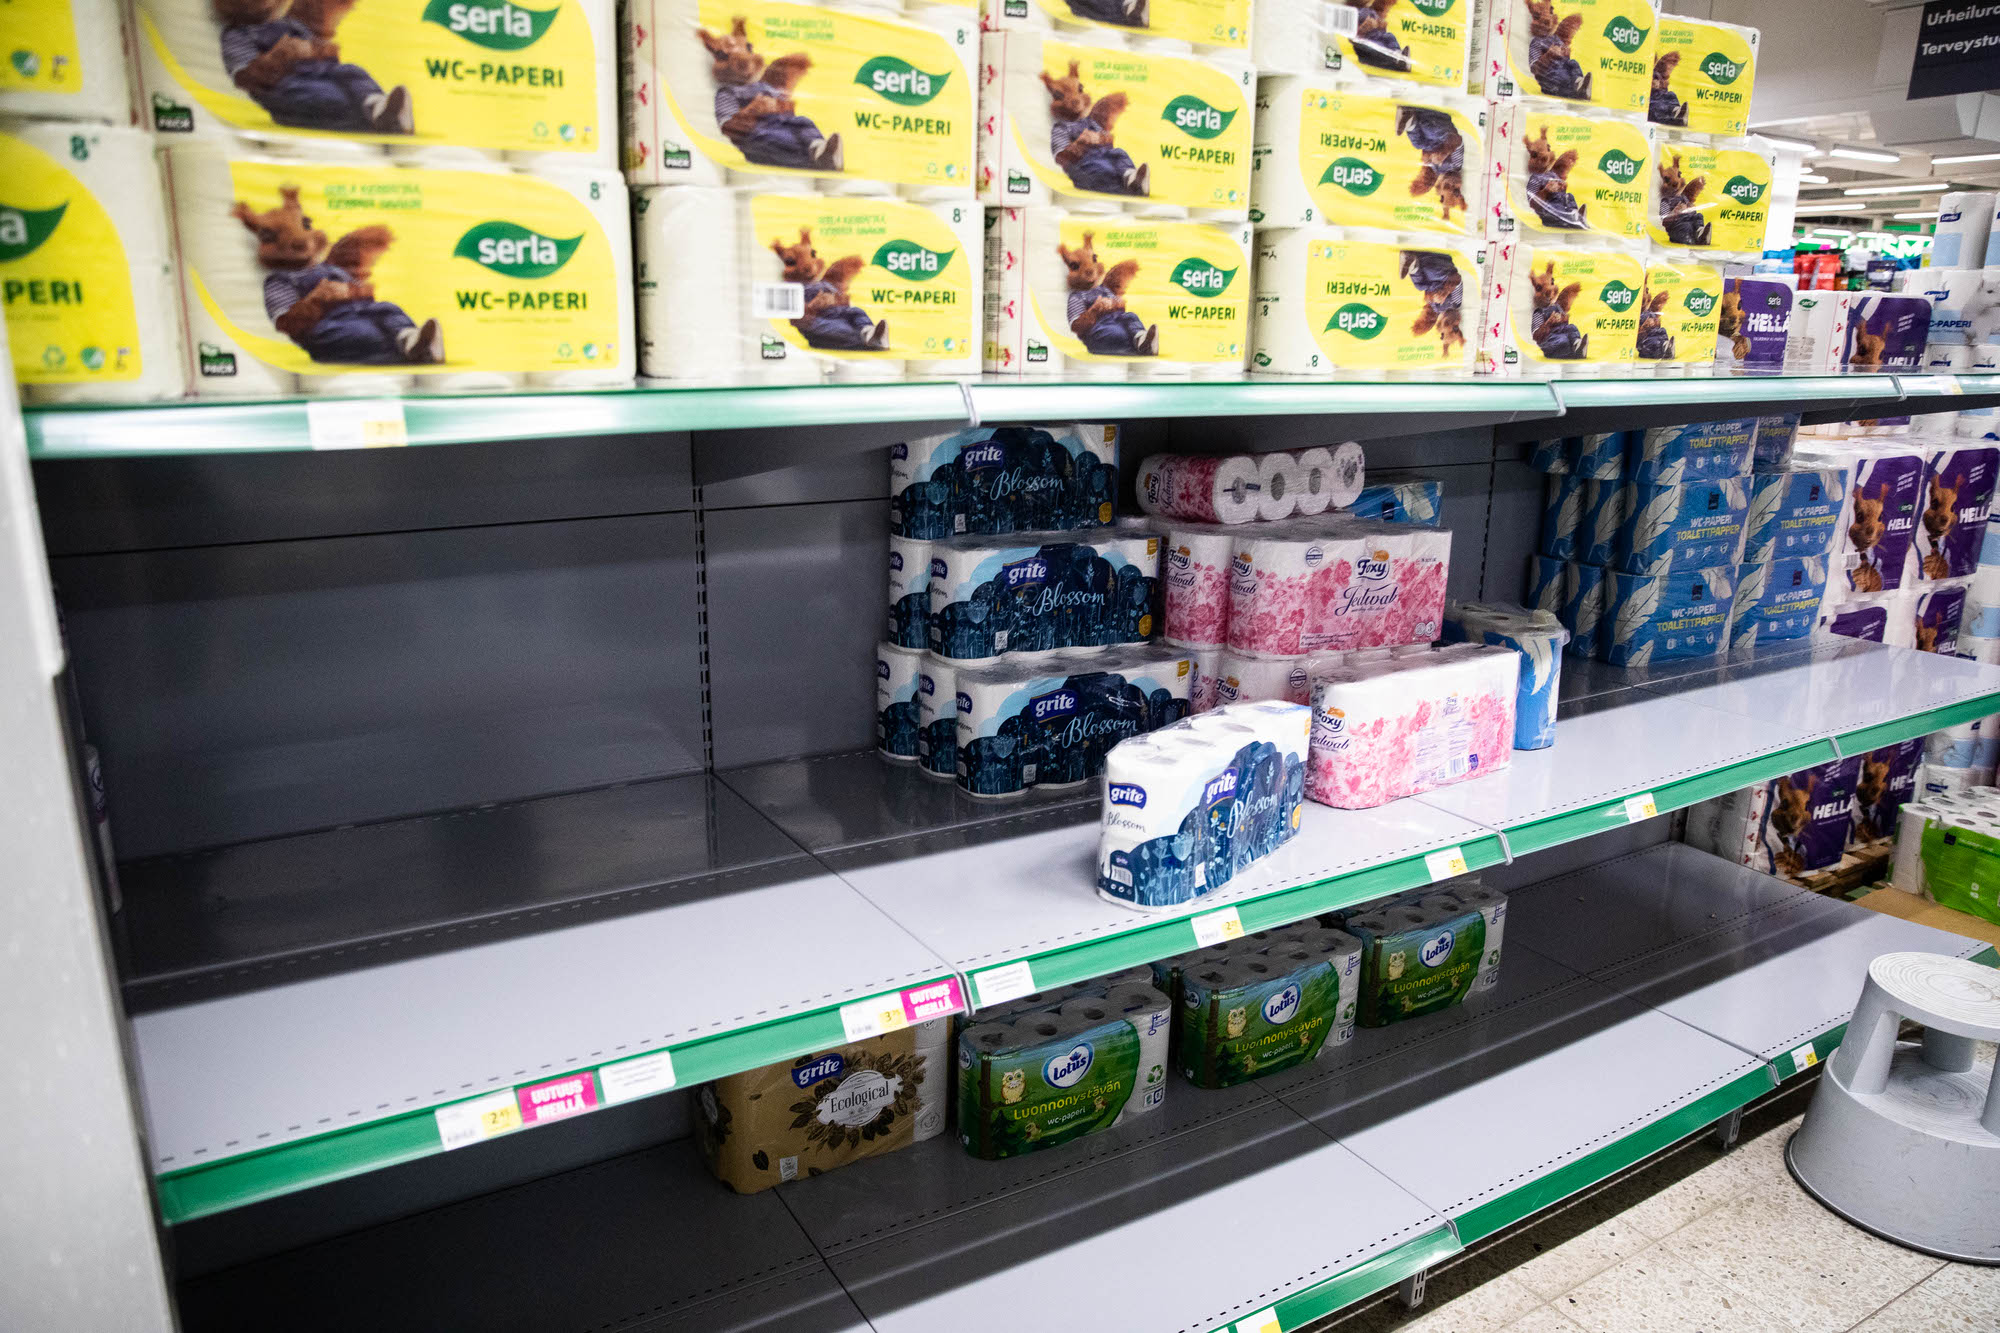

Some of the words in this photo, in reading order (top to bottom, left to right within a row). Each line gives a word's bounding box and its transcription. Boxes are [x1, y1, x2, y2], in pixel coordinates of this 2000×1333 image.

[449, 2, 532, 37] serla
[1401, 19, 1456, 39] WC-PAPERI
[1612, 27, 1640, 46] serla
[1921, 35, 2000, 56] Terveystu
[425, 58, 564, 87] WC-PAPERI
[1600, 57, 1646, 75] WC-PAPERI
[1708, 60, 1736, 78] serla
[872, 69, 931, 96] serla
[1696, 88, 1742, 104] WC-PAPERI
[855, 112, 951, 135] WC-PAPERI
[1175, 106, 1222, 130] serla
[1320, 133, 1386, 152] WC-PAPERI
[1161, 144, 1235, 165] WC-PAPERI
[1333, 165, 1374, 186] serla
[1606, 156, 1635, 176] serla
[1595, 189, 1642, 203] WC-PAPERI
[1731, 179, 1759, 199] serla
[1720, 209, 1763, 223] WC-PAPERI
[478, 234, 558, 264] serla
[886, 248, 938, 272] serla
[1182, 268, 1223, 289] serla
[1326, 281, 1391, 296] WC-PAPERI
[456, 291, 588, 310] WC-PAPERI
[871, 289, 957, 305] WC-PAPERI
[1606, 289, 1632, 305] serla
[1689, 297, 1711, 311] serla
[1168, 305, 1236, 321] WC-PAPERI
[1338, 311, 1378, 332] serla
[1596, 318, 1636, 330] WC-PAPERI
[1681, 322, 1715, 332] WC-PAPERI
[1930, 320, 1972, 328] C-PAPERI
[1702, 422, 1742, 436] WC-PAPERI
[1690, 434, 1748, 449] TOALETTPAPPER
[965, 446, 1003, 470] grite
[990, 467, 1065, 500] Blossom
[1792, 505, 1830, 517] WC-PAPERI
[1690, 515, 1733, 529] WC-PAPERI
[1781, 515, 1836, 529] TOALETTPAPPER
[1887, 517, 1913, 531] HELL
[1676, 525, 1740, 541] TOALETTPAPPER
[1169, 547, 1188, 568] Foxy
[1232, 555, 1251, 577] Foxy
[1357, 558, 1387, 577] Foxy
[1008, 562, 1047, 584] grite
[1033, 582, 1105, 616] Blossom
[1334, 583, 1399, 616] Jedwab
[1775, 589, 1813, 603] WC-PAPERI
[1671, 603, 1717, 619] WC-PAPERI
[1763, 598, 1820, 616] TOALETTPAPPER
[1657, 613, 1726, 632] TOALETTPAPPER
[1937, 641, 1957, 654] HELL
[1216, 678, 1238, 697] Foxy
[1035, 689, 1075, 718] grite
[1061, 711, 1138, 749] Blossom
[1110, 788, 1144, 803] grite
[1206, 772, 1237, 803] grite
[1107, 812, 1146, 833] Blossom
[1226, 789, 1278, 838] Blossom
[1394, 962, 1470, 994] Luonnonystävän
[909, 983, 950, 1004] UUTUUS
[1417, 984, 1445, 999] wc-paperi
[914, 996, 954, 1019] MEILLÄ
[1236, 1016, 1323, 1053] Luonnonystävän
[1262, 1042, 1294, 1059] wc-paperi
[798, 1058, 840, 1086] grite
[531, 1079, 584, 1104] UUTUUS
[830, 1081, 890, 1114] Ecological
[1013, 1080, 1121, 1121] Luonnonystävän
[536, 1094, 586, 1120] MEILLÄ
[1047, 1106, 1086, 1126] wc-paperi
